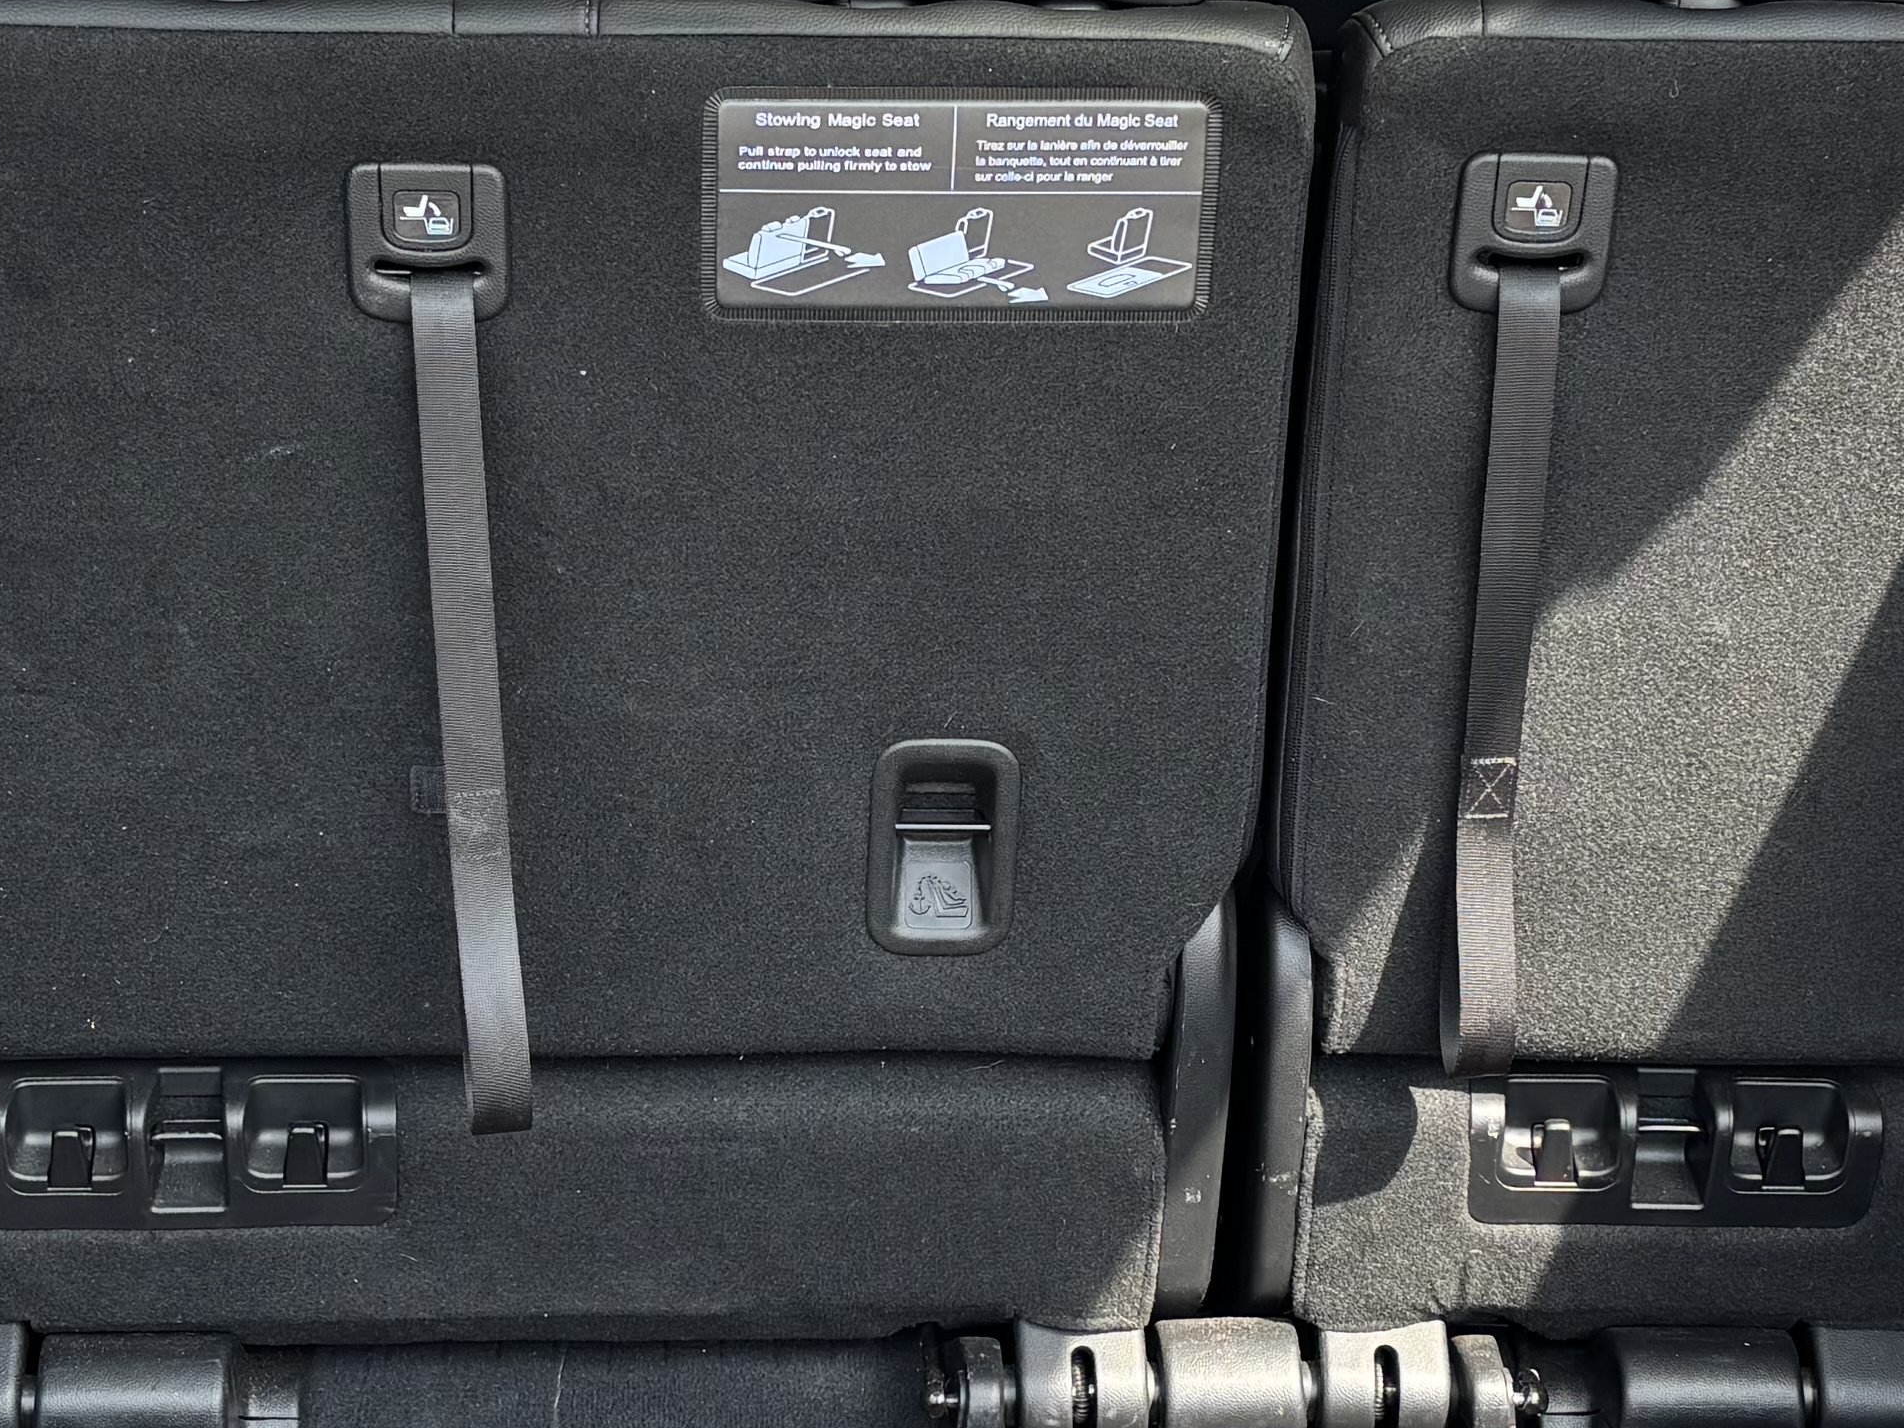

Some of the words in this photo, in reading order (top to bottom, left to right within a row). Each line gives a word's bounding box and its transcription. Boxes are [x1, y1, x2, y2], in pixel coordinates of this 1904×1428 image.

[755, 112, 821, 129] Stowing
[828, 113, 877, 129] Magic
[881, 113, 920, 127] Seat
[986, 113, 1071, 130] Rangement
[1074, 113, 1093, 128] du
[1097, 113, 1141, 130] Magic
[1144, 114, 1179, 128] Seat
[976, 140, 1005, 151] Tirez
[1007, 141, 1025, 151] sur
[1027, 140, 1038, 151] la
[1040, 139, 1077, 151] lanière
[1080, 139, 1101, 151] afin
[1103, 140, 1118, 151] de
[1120, 139, 1188, 151] déverrouiller
[739, 146, 764, 157] Pull
[767, 147, 801, 159] strap
[804, 147, 817, 157] to
[819, 146, 861, 157] unlock
[864, 147, 893, 157] seat
[897, 146, 922, 157] and
[738, 161, 794, 171] continue
[797, 161, 841, 172] pulling
[844, 161, 883, 173] firmly
[885, 161, 897, 171] to
[900, 162, 932, 171] stow
[975, 156, 986, 167] la
[988, 156, 1047, 169] banquette,
[1049, 157, 1071, 167] tout
[1072, 158, 1088, 167] en
[1090, 156, 1147, 167] continuant
[1149, 156, 1158, 167] à
[1160, 157, 1183, 167] tirer
[975, 173, 994, 182] sur
[995, 171, 1034, 182] celle-ci
[1036, 173, 1062, 184] pour
[1064, 172, 1075, 182] la
[1076, 172, 1114, 184] ranger
